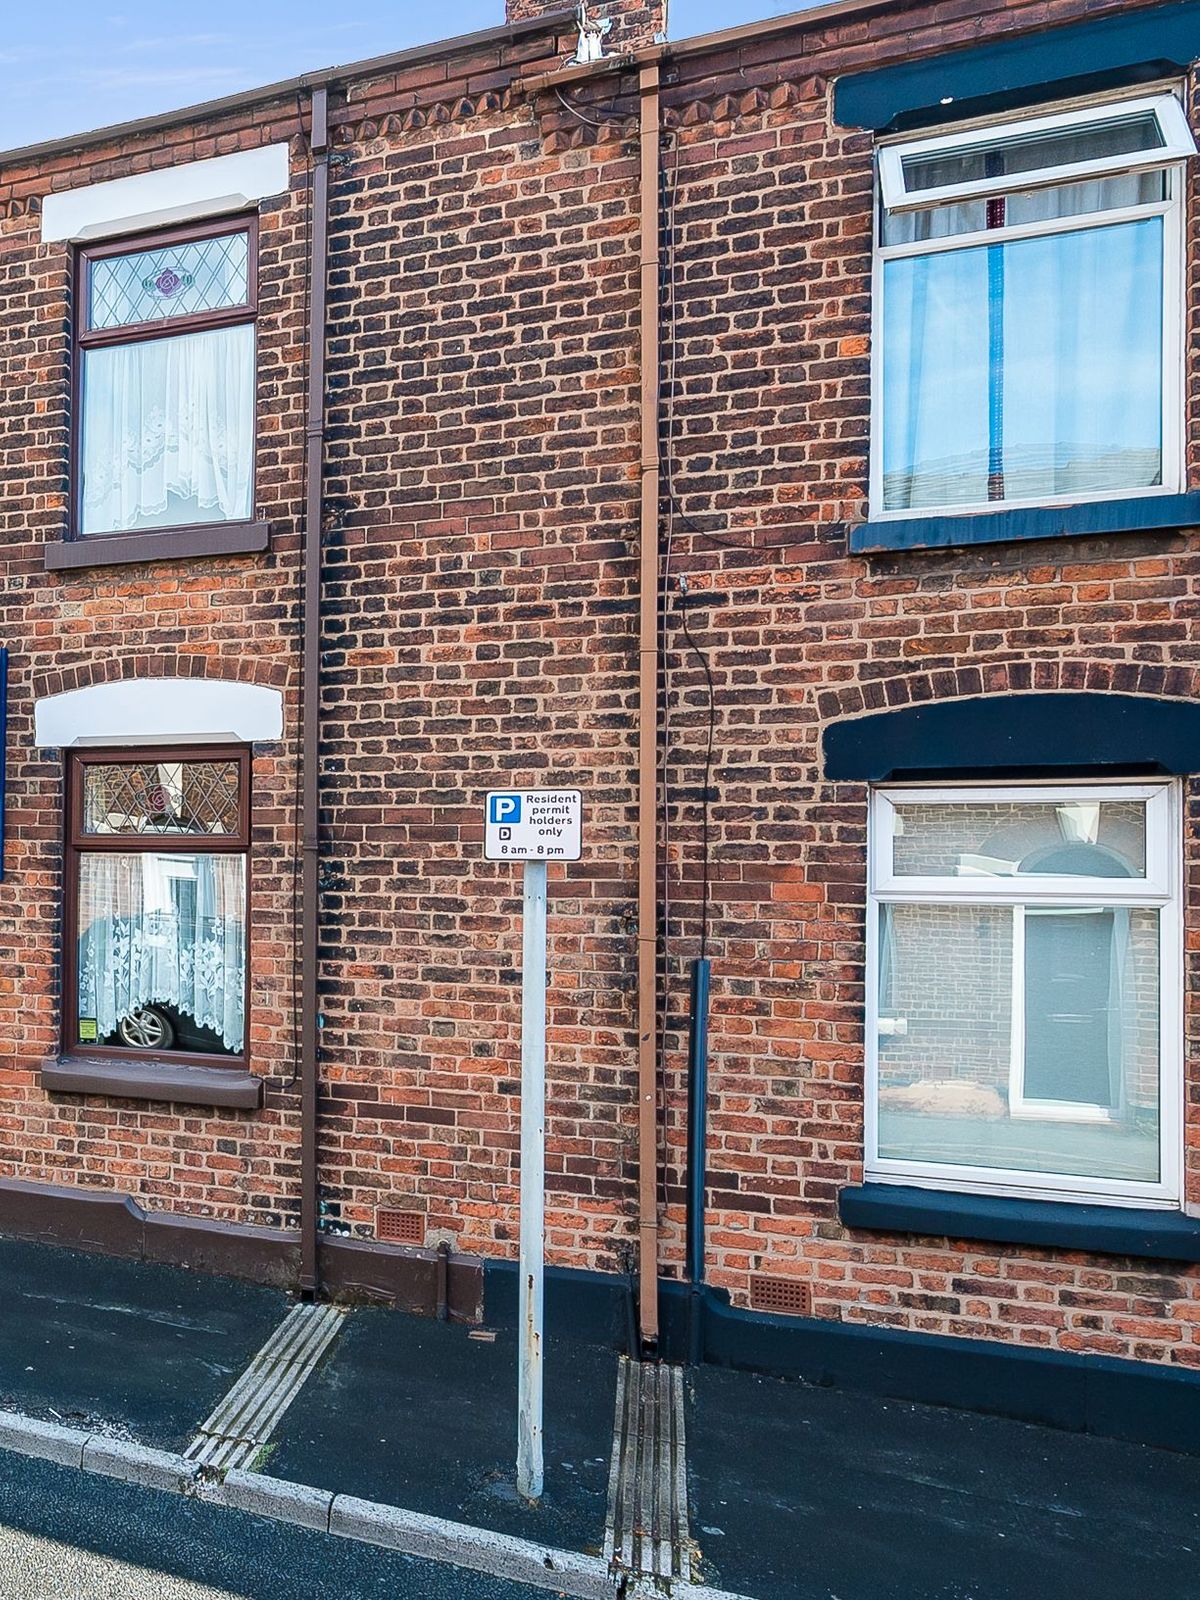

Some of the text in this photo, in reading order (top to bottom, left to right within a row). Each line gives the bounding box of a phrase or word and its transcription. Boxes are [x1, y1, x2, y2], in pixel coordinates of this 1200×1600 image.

[526, 794, 577, 804] Resident
[495, 797, 516, 822] P
[532, 805, 570, 815] permit
[529, 816, 573, 825] holders
[538, 827, 563, 837] only
[501, 845, 508, 854] 8
[537, 845, 544, 854] 8
[546, 847, 564, 855] pm
